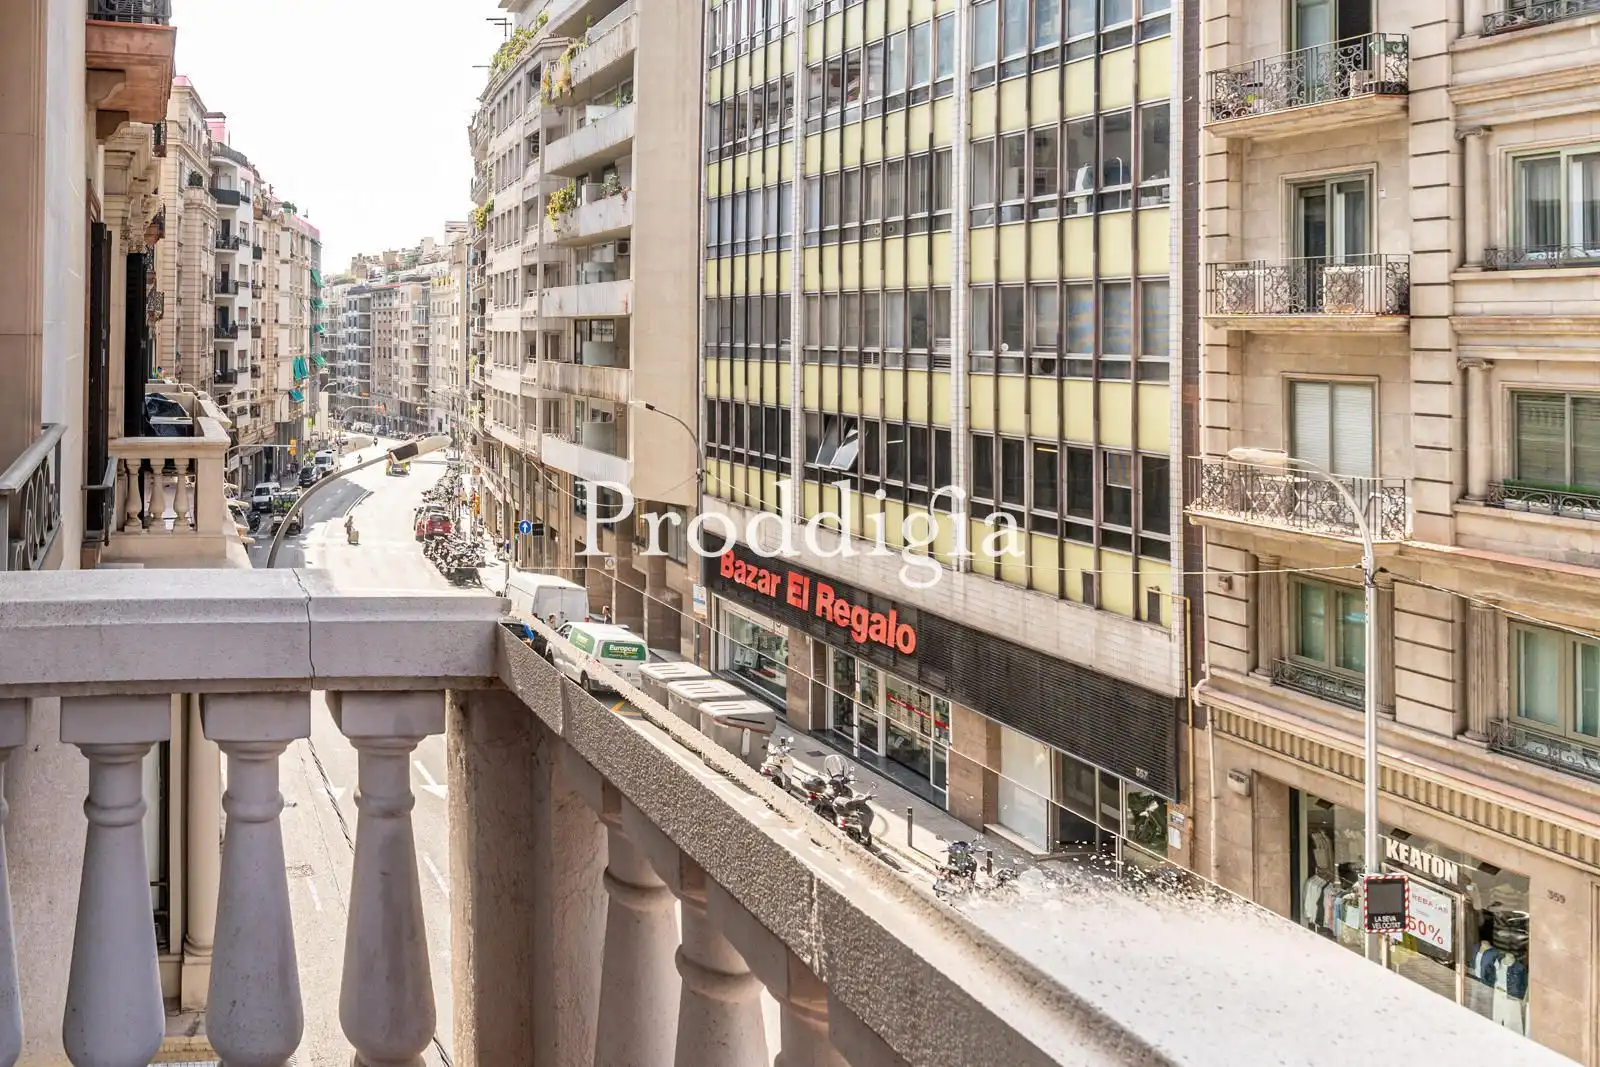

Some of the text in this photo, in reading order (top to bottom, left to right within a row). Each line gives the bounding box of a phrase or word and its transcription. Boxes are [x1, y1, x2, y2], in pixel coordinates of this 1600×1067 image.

[720, 549, 917, 655] Bazar El Regalo
[609, 644, 639, 654] Europcar
[1386, 838, 1459, 885] KEATON
